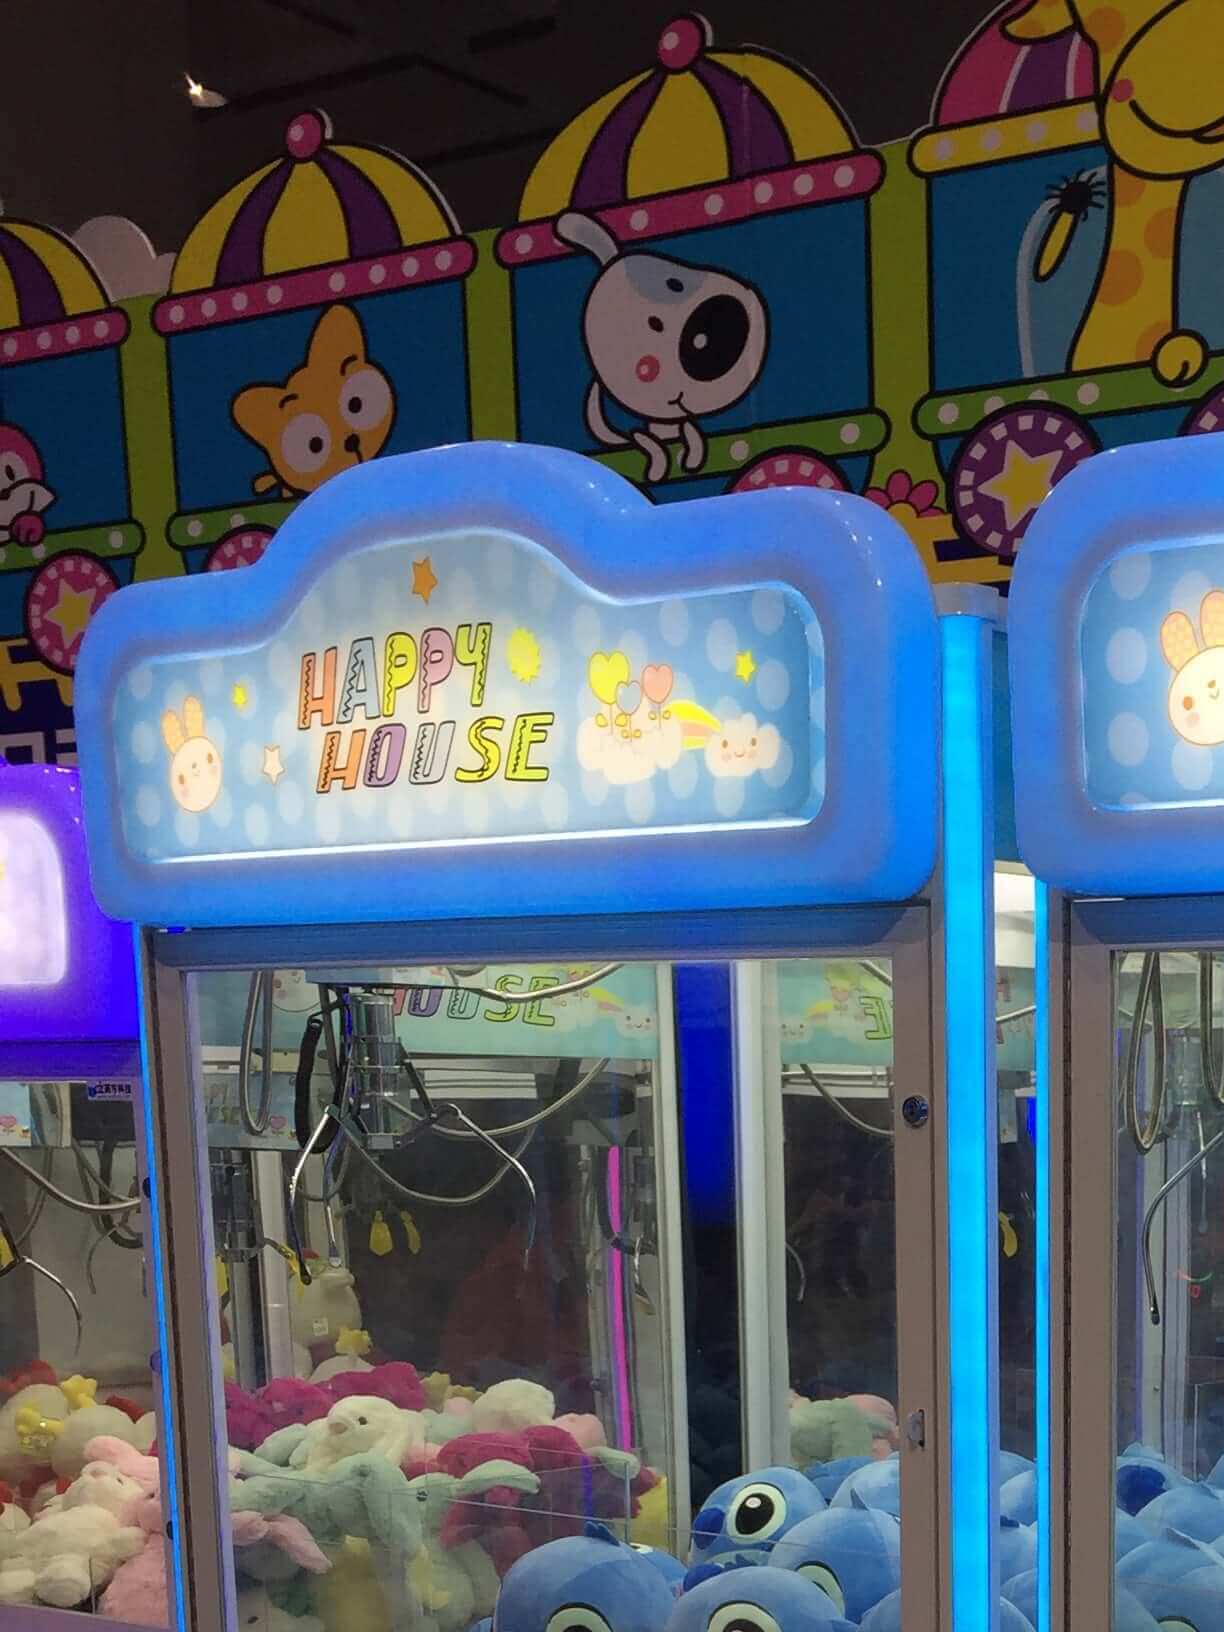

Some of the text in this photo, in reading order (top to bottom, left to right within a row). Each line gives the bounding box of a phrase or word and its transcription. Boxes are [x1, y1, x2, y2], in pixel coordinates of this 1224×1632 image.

[297, 622, 493, 730] HAPPY
[316, 712, 555, 794] HOUSE
[394, 974, 556, 1027] OUSE
